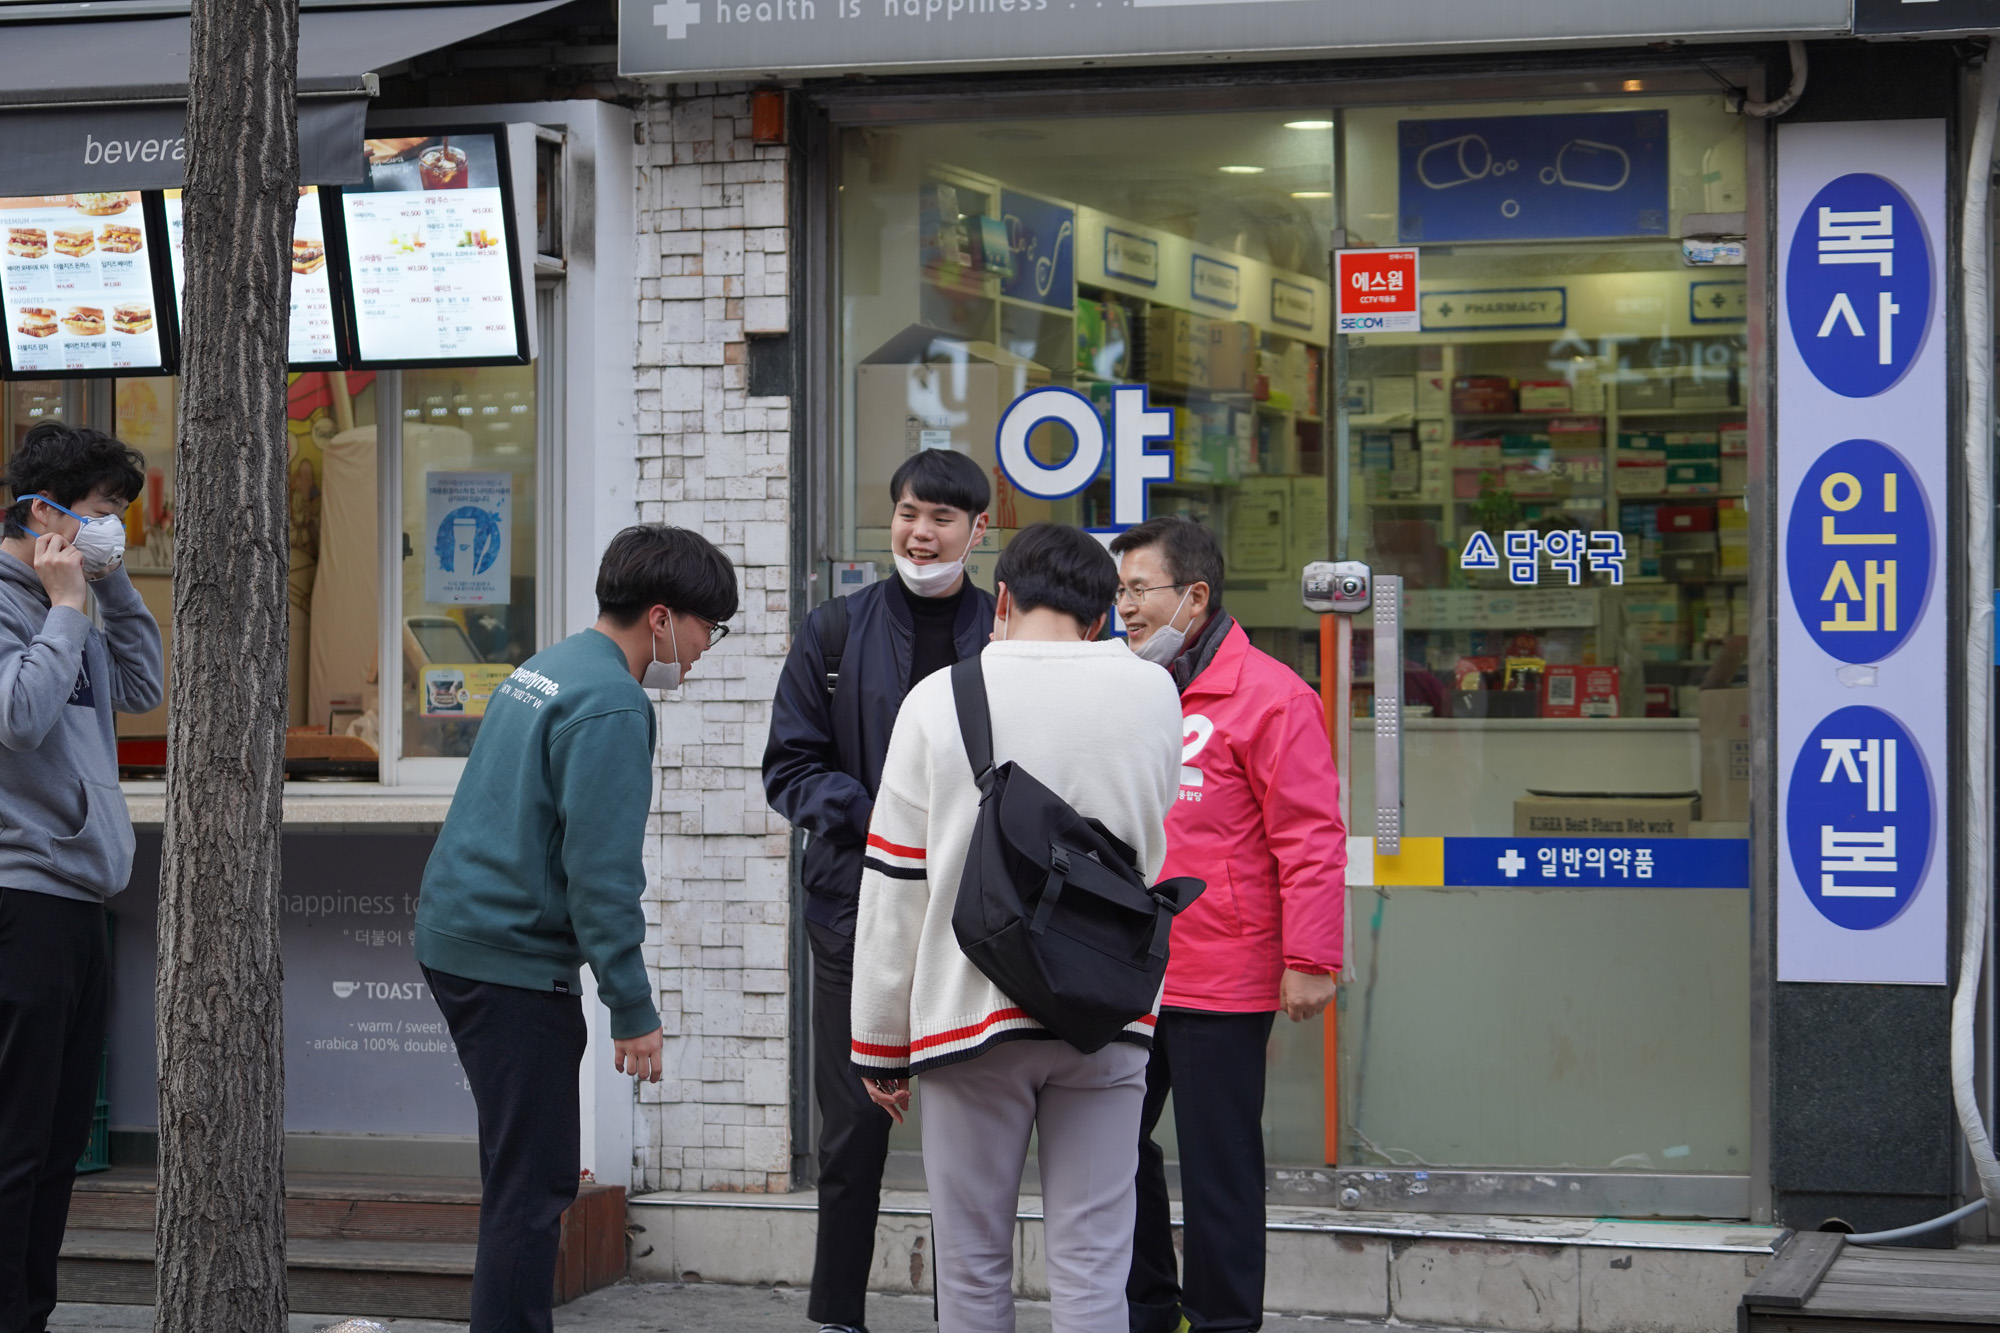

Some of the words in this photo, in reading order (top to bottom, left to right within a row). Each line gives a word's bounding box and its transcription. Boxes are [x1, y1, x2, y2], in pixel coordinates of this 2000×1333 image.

[717, 0, 815, 23] health
[1351, 270, 1403, 291] 에스원
[1817, 205, 1899, 365] 복사
[1464, 301, 1547, 314] PHARMACY
[1341, 317, 1383, 329] SECOM
[1460, 530, 1626, 585] 소담약국
[1821, 473, 1897, 632] 인쇄
[1181, 714, 1214, 787] 2
[1565, 817, 1589, 832] Best
[1592, 818, 1624, 833] Pharm
[1647, 819, 1674, 833] work
[1821, 739, 1897, 897] 제본
[1537, 848, 1655, 878] 일반의약품
[355, 929, 402, 946] 더불어
[364, 982, 424, 999] TOAST
[358, 1022, 393, 1033] warm
[405, 1021, 442, 1034] sweet
[314, 1036, 358, 1050] arabica
[363, 1038, 400, 1051] 100%
[404, 1038, 447, 1052] double
